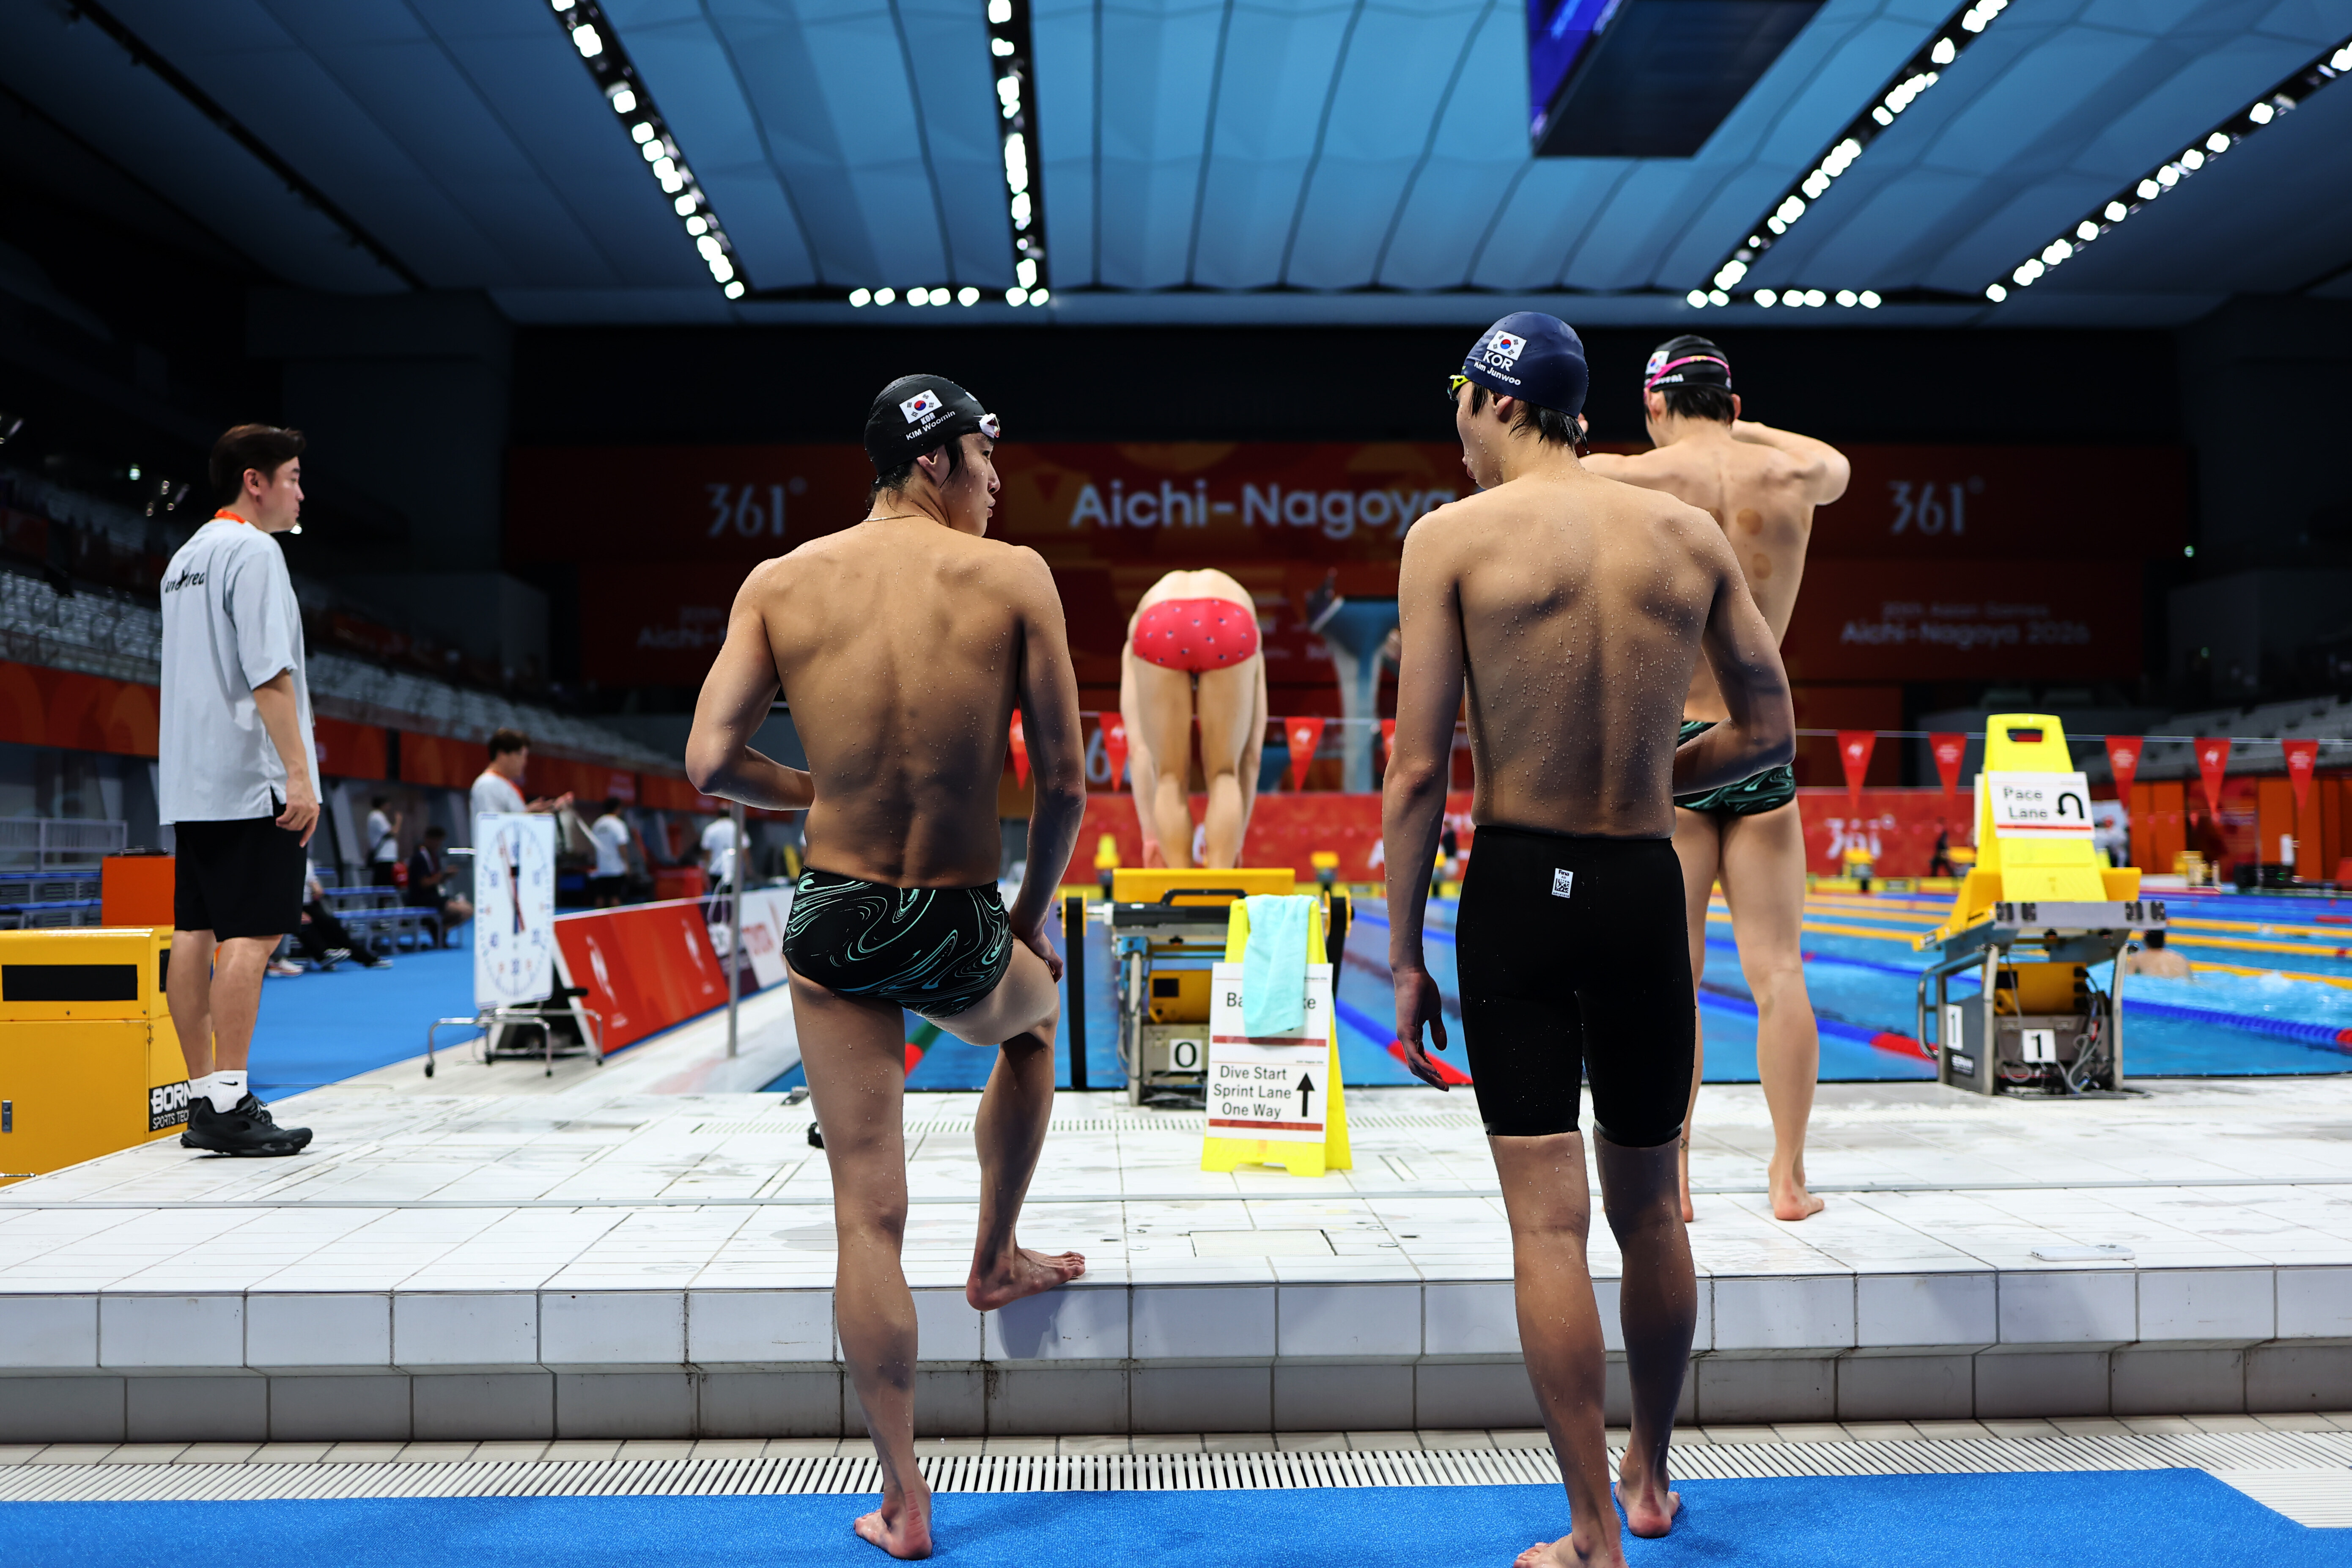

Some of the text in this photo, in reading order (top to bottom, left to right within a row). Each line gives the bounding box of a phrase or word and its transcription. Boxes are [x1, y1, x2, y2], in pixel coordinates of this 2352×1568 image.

[1482, 351, 1513, 372] KOR
[1474, 360, 1521, 385] Kim Junwoo
[906, 411, 955, 441] KIM Woomin
[920, 412, 936, 425] KOR
[2003, 786, 2043, 802] Pace
[2009, 805, 2048, 820] Lane
[1951, 1011, 1957, 1044] 1
[1175, 1042, 1197, 1068] 0
[2031, 1034, 2042, 1058] 1
[1220, 1065, 1287, 1080] Dive Start
[1213, 1083, 1291, 1099] Sprint Lane
[1222, 1102, 1282, 1120] One Way
[153, 1113, 175, 1129] SPORTS
